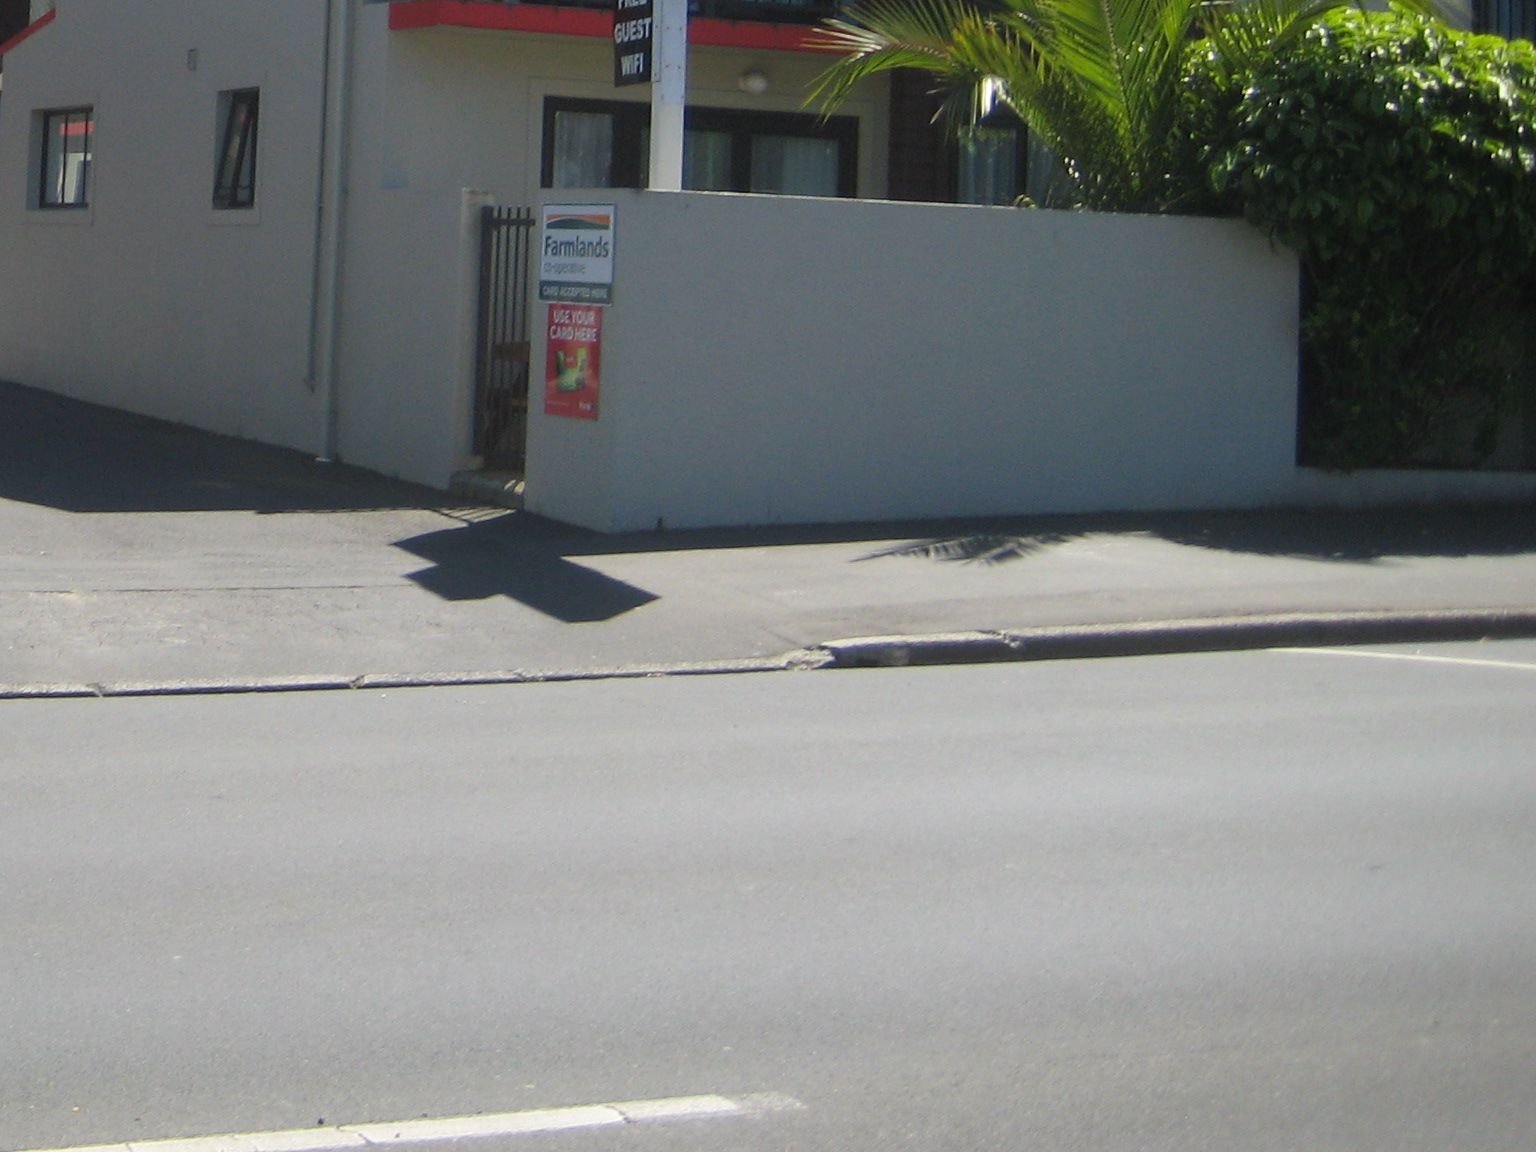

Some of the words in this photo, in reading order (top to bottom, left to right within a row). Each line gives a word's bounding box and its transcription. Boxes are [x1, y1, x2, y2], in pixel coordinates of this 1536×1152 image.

[614, 16, 651, 44] GUEST
[621, 52, 644, 76] WIFI
[545, 235, 609, 258] Farmlands
[553, 309, 571, 324] USE
[572, 310, 596, 325] YOUR
[550, 325, 573, 340] CARD
[574, 327, 597, 342] HERE
